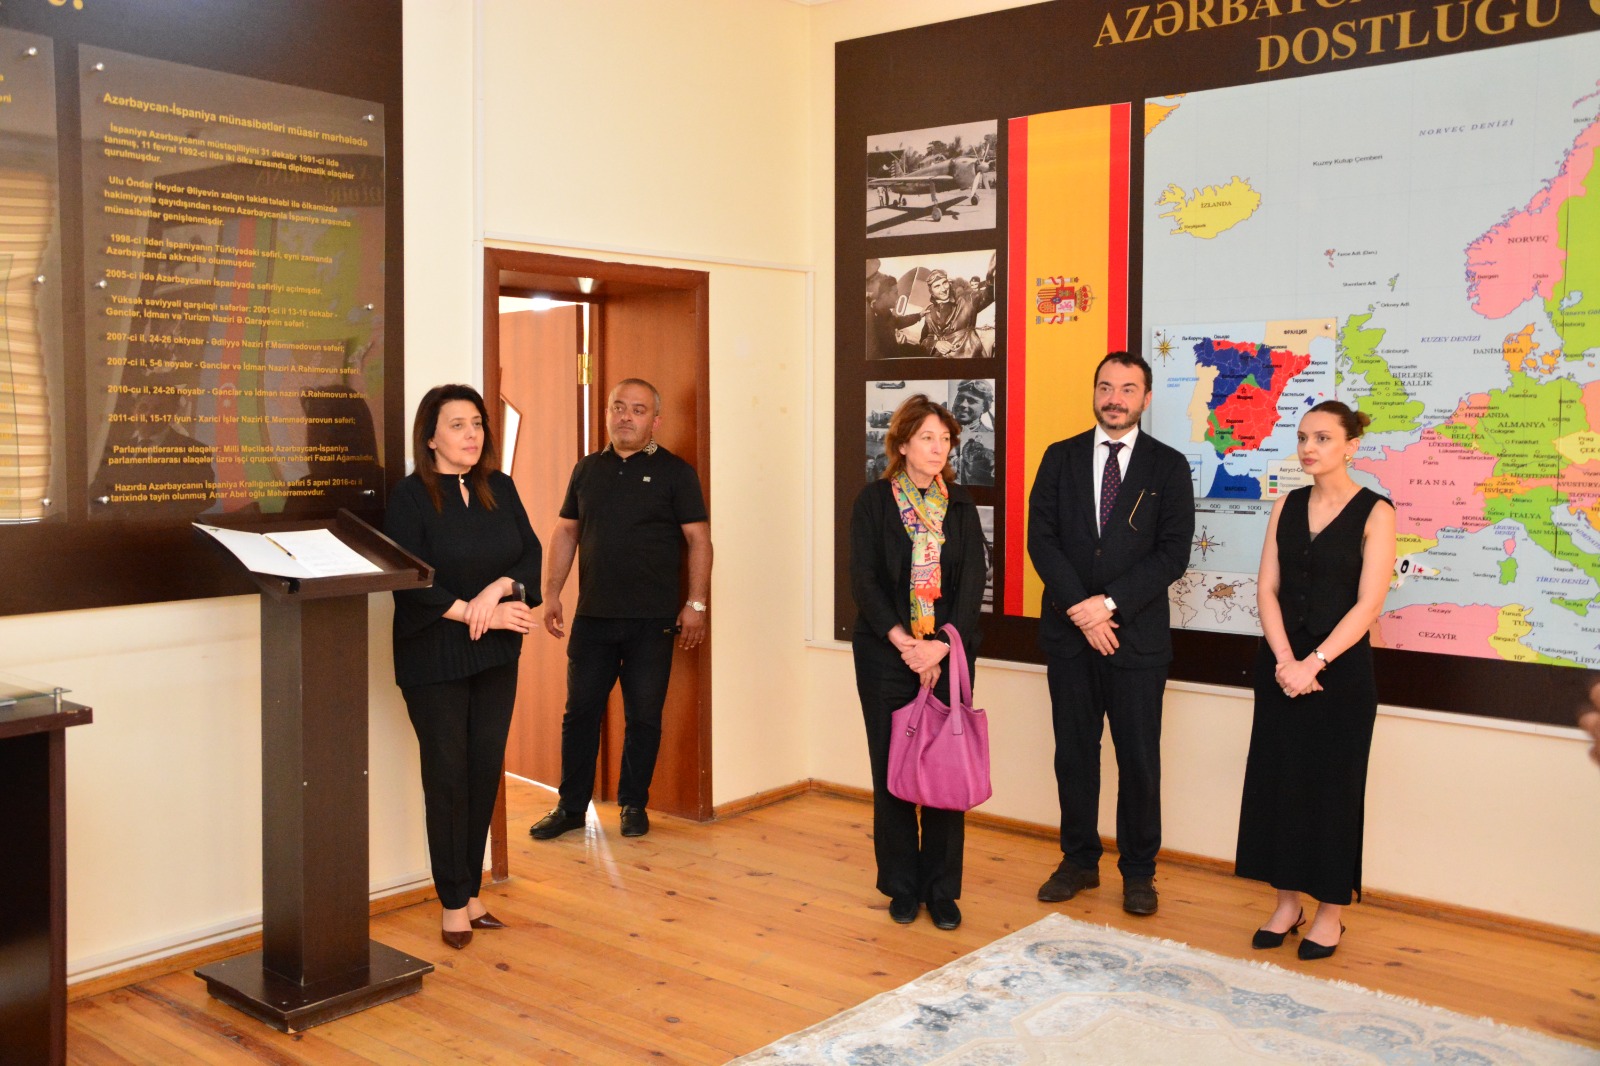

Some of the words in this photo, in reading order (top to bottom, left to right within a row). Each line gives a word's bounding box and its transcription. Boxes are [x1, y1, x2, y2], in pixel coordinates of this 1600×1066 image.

[103, 92, 216, 122] Azərbaycan-İspaniya
[288, 126, 320, 138] müasir
[1418, 125, 1465, 137] NORVEÇ
[1471, 118, 1514, 131] DENİZİ
[141, 140, 150, 149] 11
[153, 142, 176, 153] fevral
[261, 149, 270, 157] 31
[272, 150, 297, 161] dekabr
[108, 175, 124, 185] Ulu
